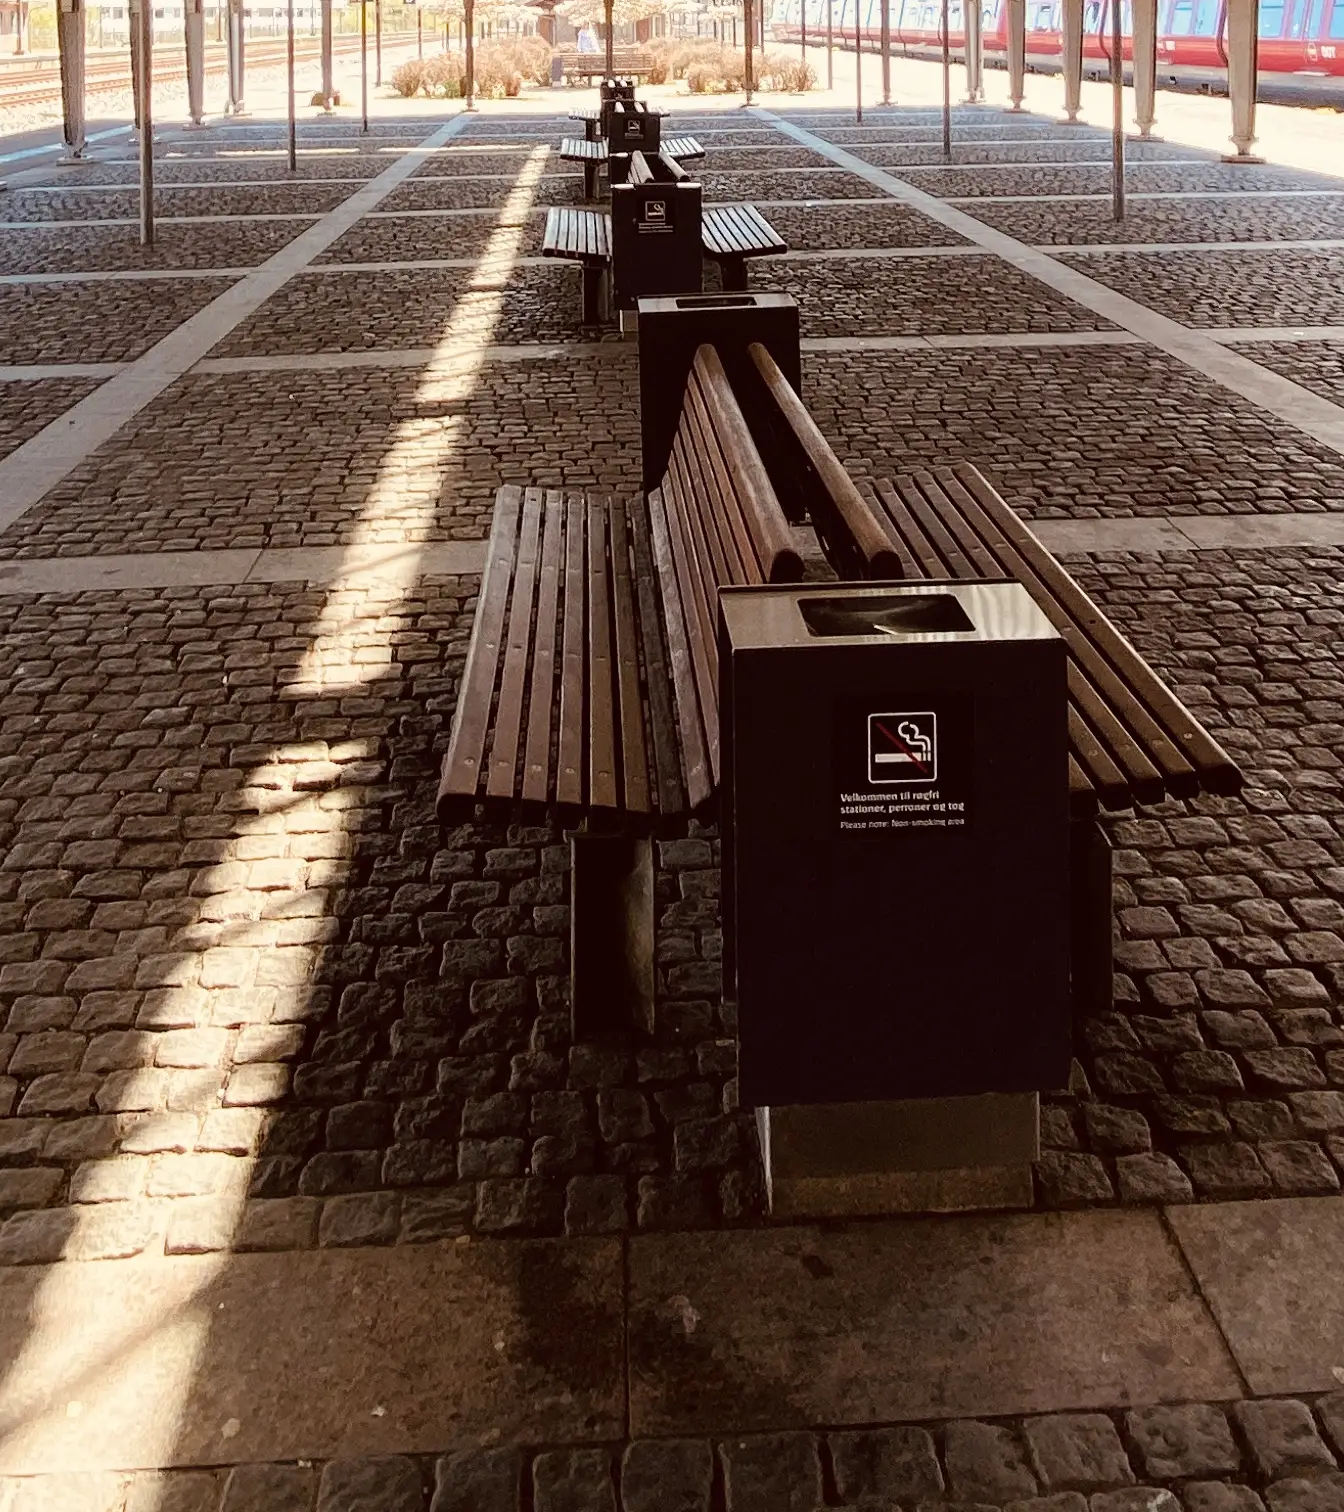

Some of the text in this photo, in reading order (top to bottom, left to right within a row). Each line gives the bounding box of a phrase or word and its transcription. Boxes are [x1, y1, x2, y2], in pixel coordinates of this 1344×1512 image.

[840, 793, 898, 802] Velkommen
[900, 791, 911, 801] til
[840, 802, 965, 814] stationer, perroner og tog
[840, 821, 867, 829] Please
[947, 818, 965, 826] area
